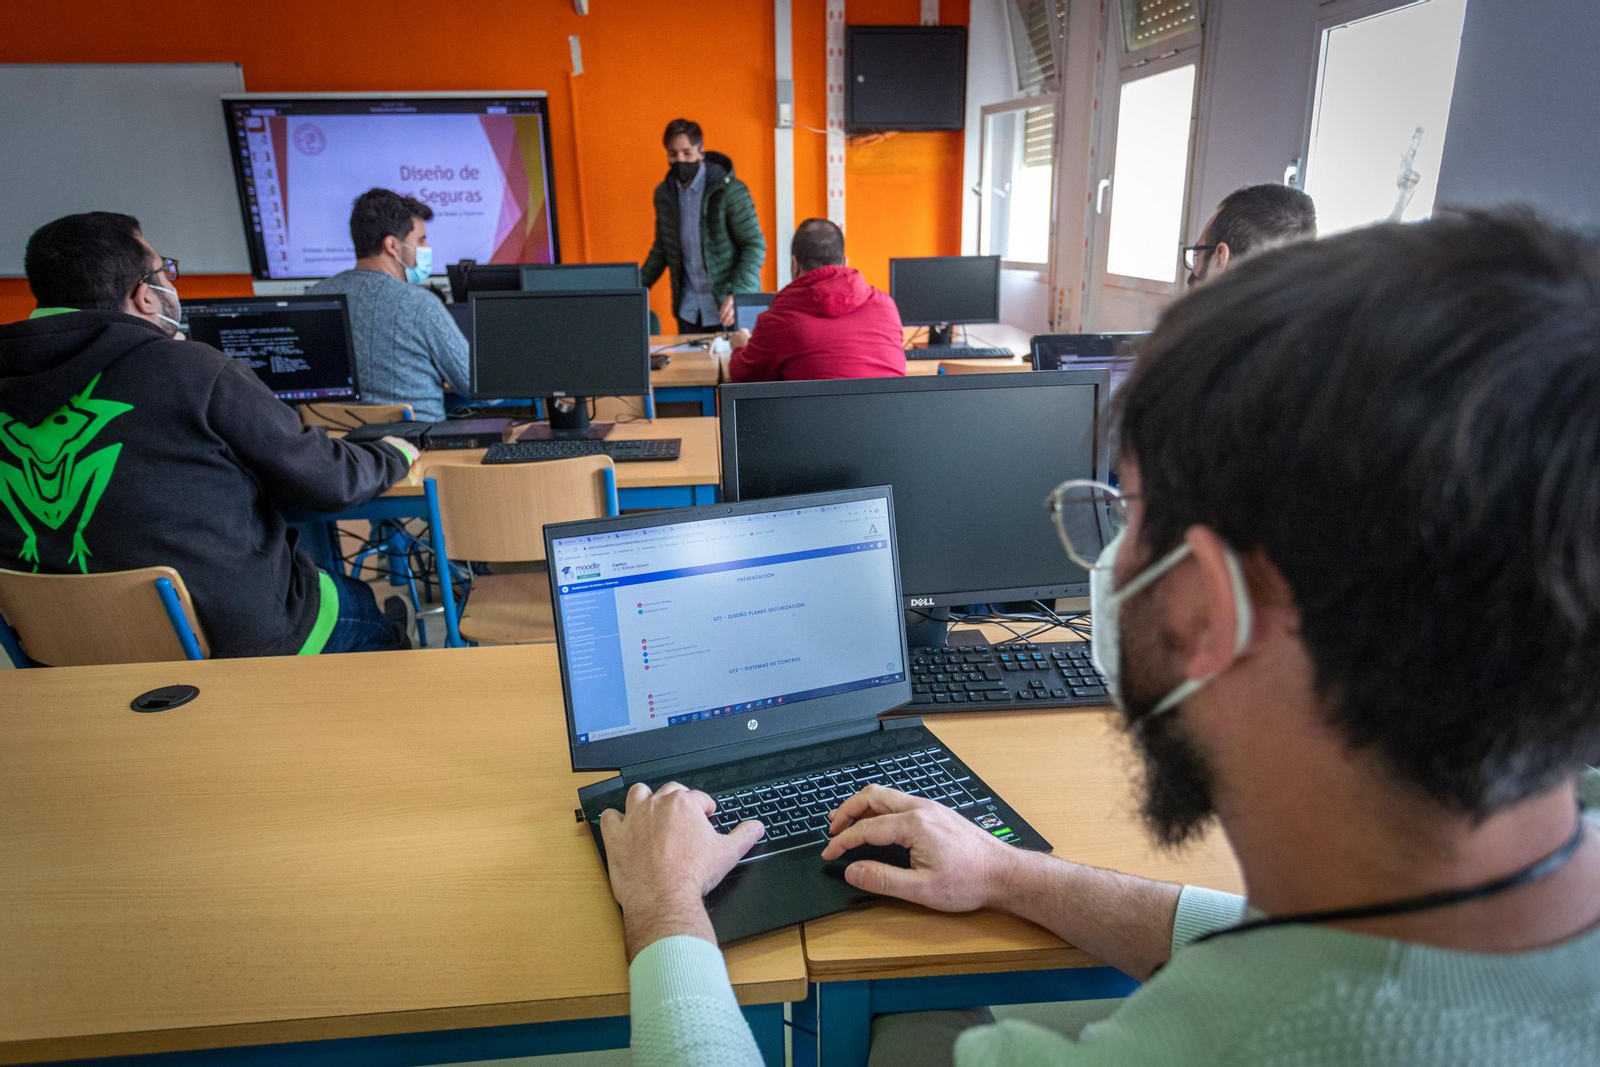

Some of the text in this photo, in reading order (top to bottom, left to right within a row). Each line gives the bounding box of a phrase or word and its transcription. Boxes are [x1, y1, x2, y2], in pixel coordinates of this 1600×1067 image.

[400, 164, 480, 181] Diseño de
[418, 188, 484, 206] Seguras
[576, 562, 600, 571] moodle
[736, 572, 775, 582] PRESENTACIÓN
[910, 598, 935, 606] DELL
[728, 611, 748, 620] DISEÑO
[768, 602, 805, 612] SECURIZACIÓN
[744, 662, 769, 672] SISTEMAS
[778, 657, 802, 665] CONTROL
